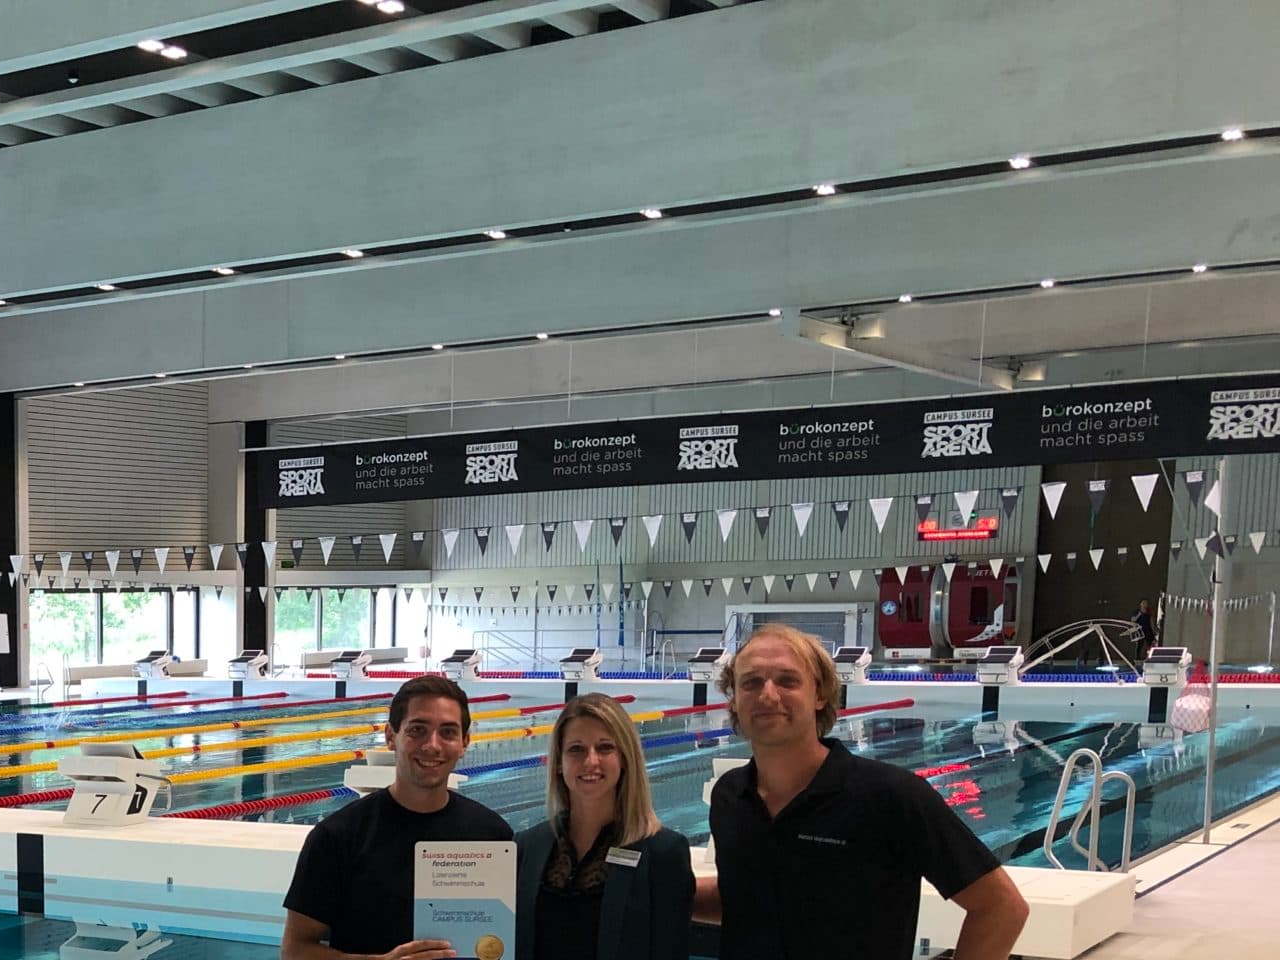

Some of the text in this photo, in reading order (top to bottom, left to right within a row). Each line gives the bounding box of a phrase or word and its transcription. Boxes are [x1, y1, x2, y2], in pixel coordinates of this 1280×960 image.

[1213, 391, 1250, 401] CAMPUS
[925, 409, 993, 422] CAMPUS SURSEE
[1042, 398, 1152, 418] bürokonzept
[680, 425, 738, 438] CAMPUS SURSEE
[780, 419, 874, 435] bürokonzept
[924, 423, 992, 441] SPORT
[1041, 414, 1160, 434] und die arbeit
[467, 442, 491, 453] CAMPUS
[679, 439, 738, 455] SPORT
[779, 433, 880, 450] und die arbeit
[921, 437, 993, 458] ARENA
[1040, 431, 1145, 448] macht spass
[466, 454, 518, 469] SPORT
[554, 448, 642, 464] und die arbeit
[677, 452, 739, 470] ARENA
[778, 448, 868, 463] macht spass
[279, 469, 324, 483] SPORT
[355, 463, 434, 479] und die arbeit
[465, 467, 518, 484] ARENA
[553, 462, 632, 476] macht spass
[278, 480, 325, 496] ARENA
[355, 477, 425, 490] macht spass
[1160, 674, 1168, 684] 8
[90, 794, 107, 814] 7
